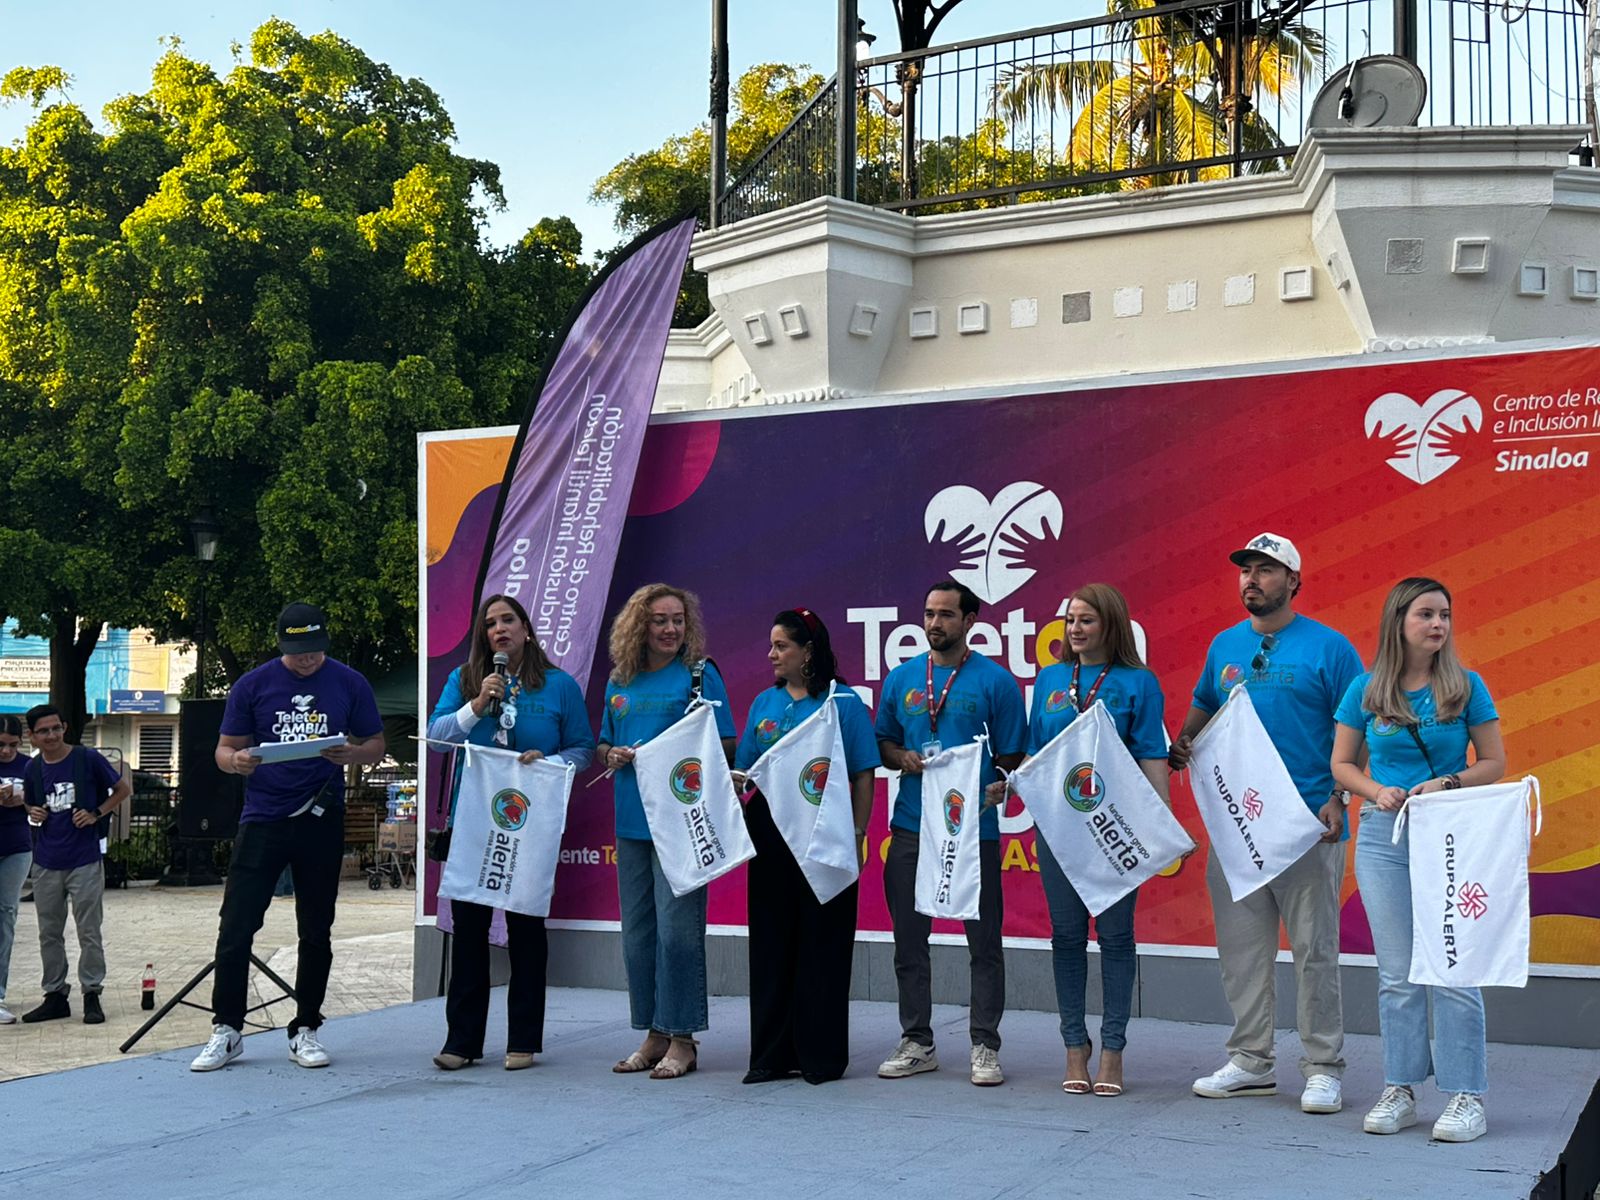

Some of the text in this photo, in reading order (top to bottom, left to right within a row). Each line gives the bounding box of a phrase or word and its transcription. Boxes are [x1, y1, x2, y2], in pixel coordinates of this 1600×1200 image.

[1493, 394, 1553, 412] Centro
[1557, 388, 1581, 408] de
[1494, 420, 1504, 434] e
[1508, 411, 1588, 433] Inclusión
[1495, 447, 1589, 472] Sinaloa
[272, 723, 328, 735] CAMBIA
[275, 710, 328, 723] Teletón
[690, 806, 715, 867] alerta
[1092, 812, 1138, 871] alerta
[1108, 803, 1150, 860] fundación grupo
[711, 837, 726, 859] grupo
[486, 832, 511, 890] alerta
[1443, 833, 1458, 970] GRUPOALERTA
